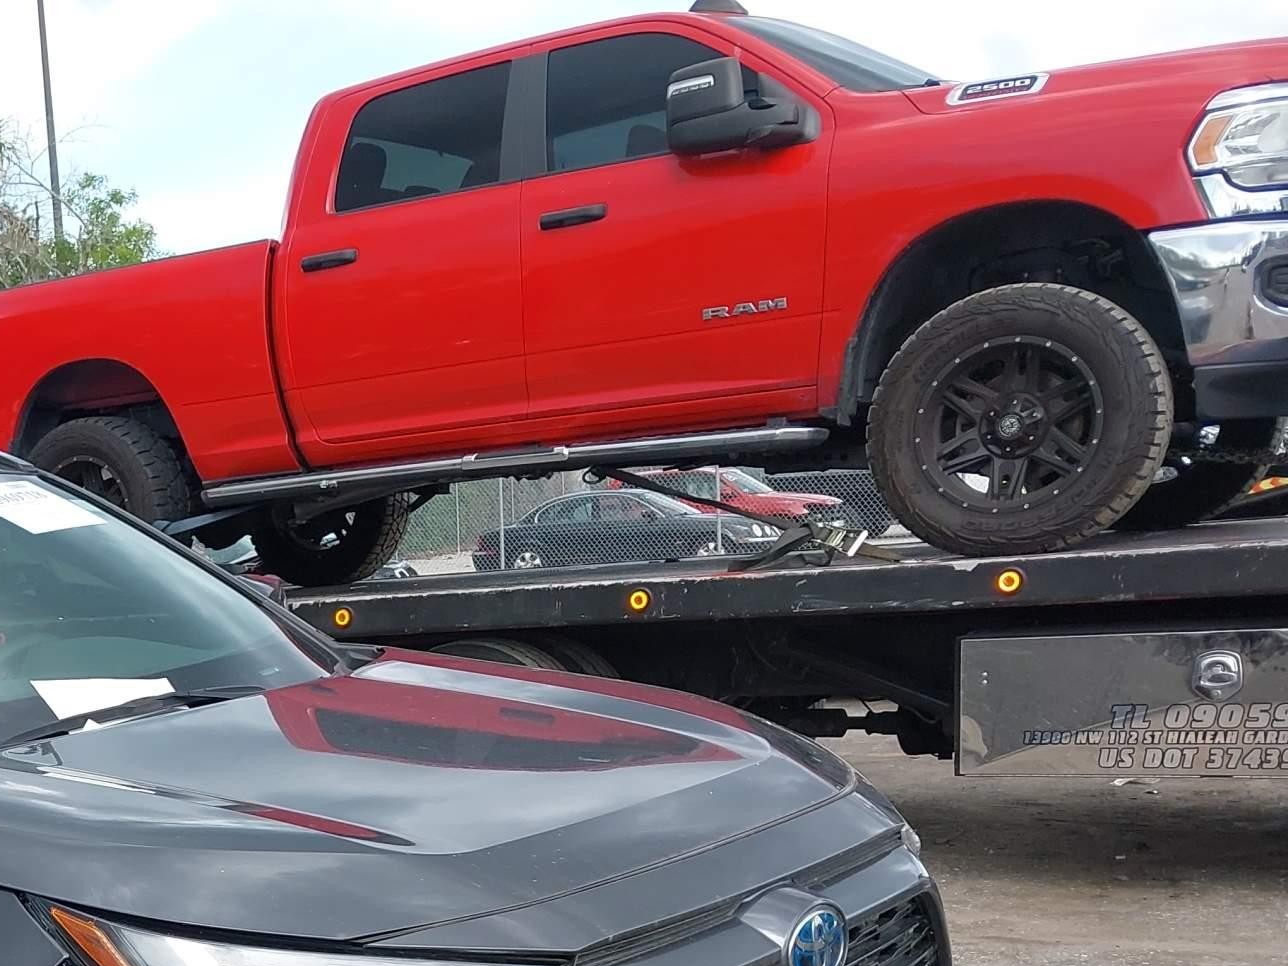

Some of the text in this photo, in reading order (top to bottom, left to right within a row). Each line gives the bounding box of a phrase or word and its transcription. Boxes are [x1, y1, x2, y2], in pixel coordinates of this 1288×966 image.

[966, 78, 1032, 94] 2500
[702, 297, 787, 320] RAM
[1111, 703, 1288, 730] TL 09059
[1073, 730, 1104, 745] NW
[1107, 730, 1139, 745] 112
[1143, 730, 1164, 745] ST
[1165, 730, 1242, 745] HIALEAH
[1098, 748, 1136, 769] US
[1142, 748, 1198, 769] DOT
